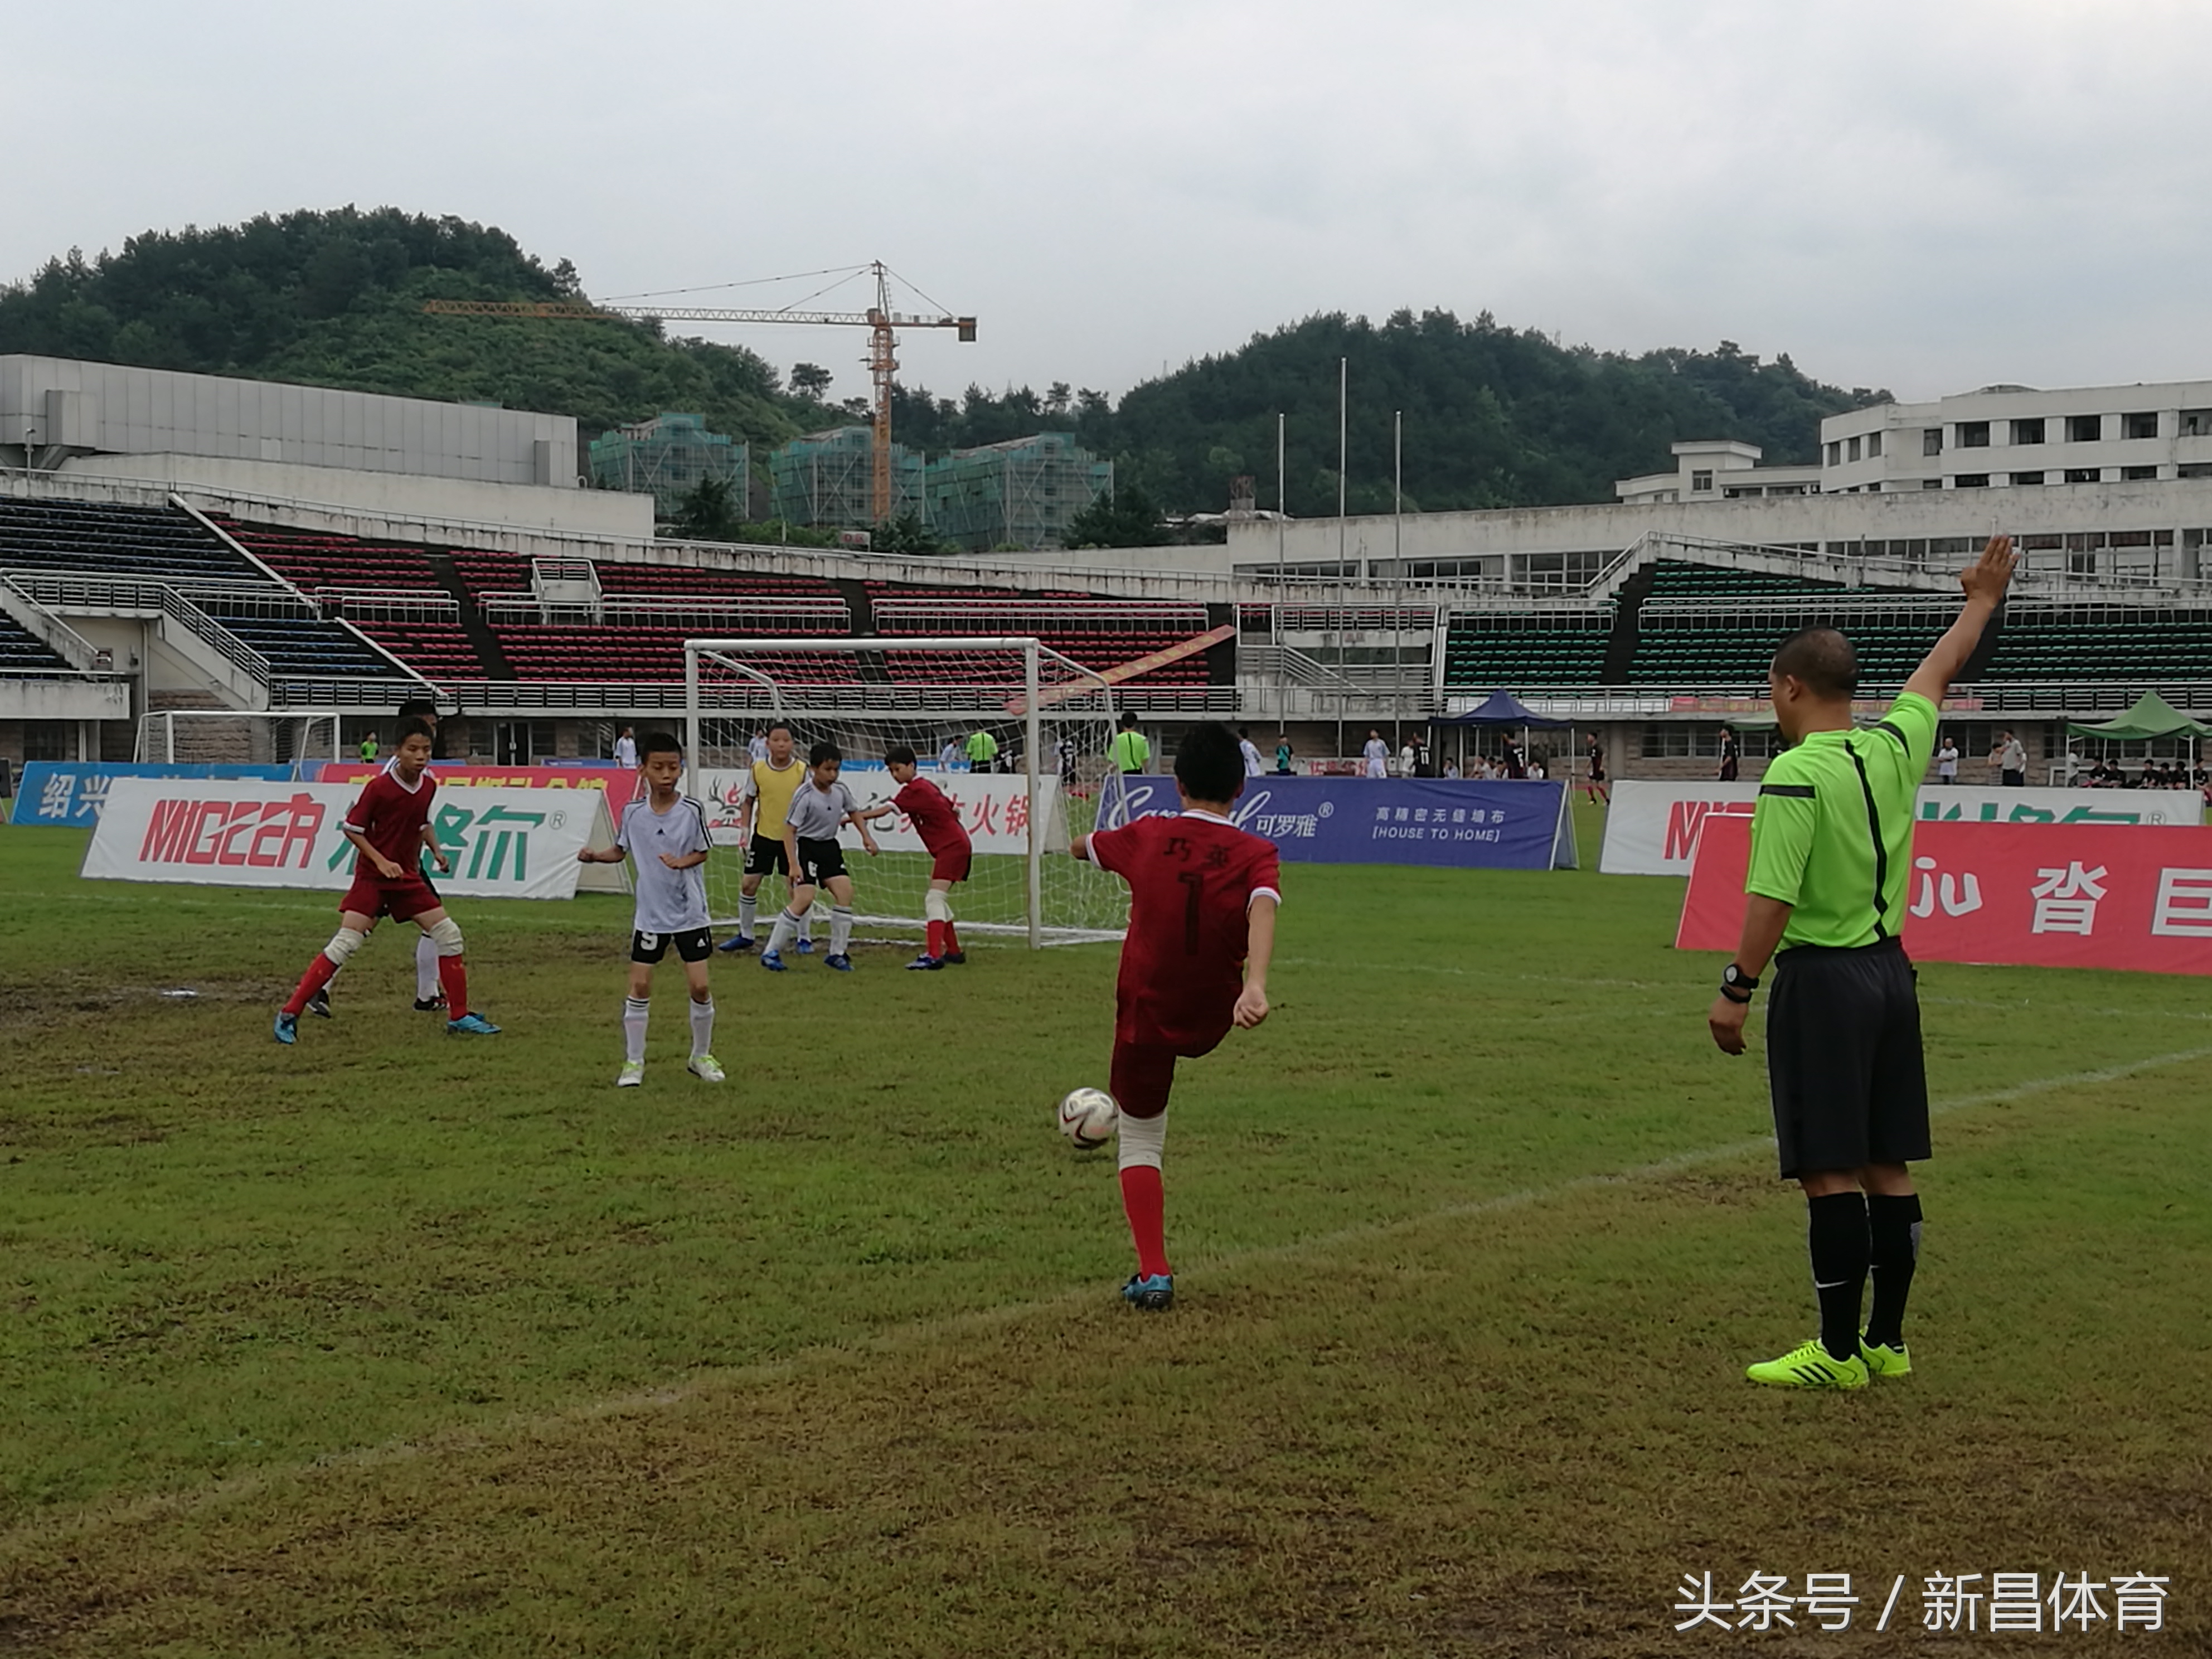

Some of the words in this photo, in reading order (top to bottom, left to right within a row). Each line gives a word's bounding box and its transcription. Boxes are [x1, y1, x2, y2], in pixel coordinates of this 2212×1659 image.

[1256, 814, 1318, 837] 可罗雅
[1431, 828, 1448, 840] TO
